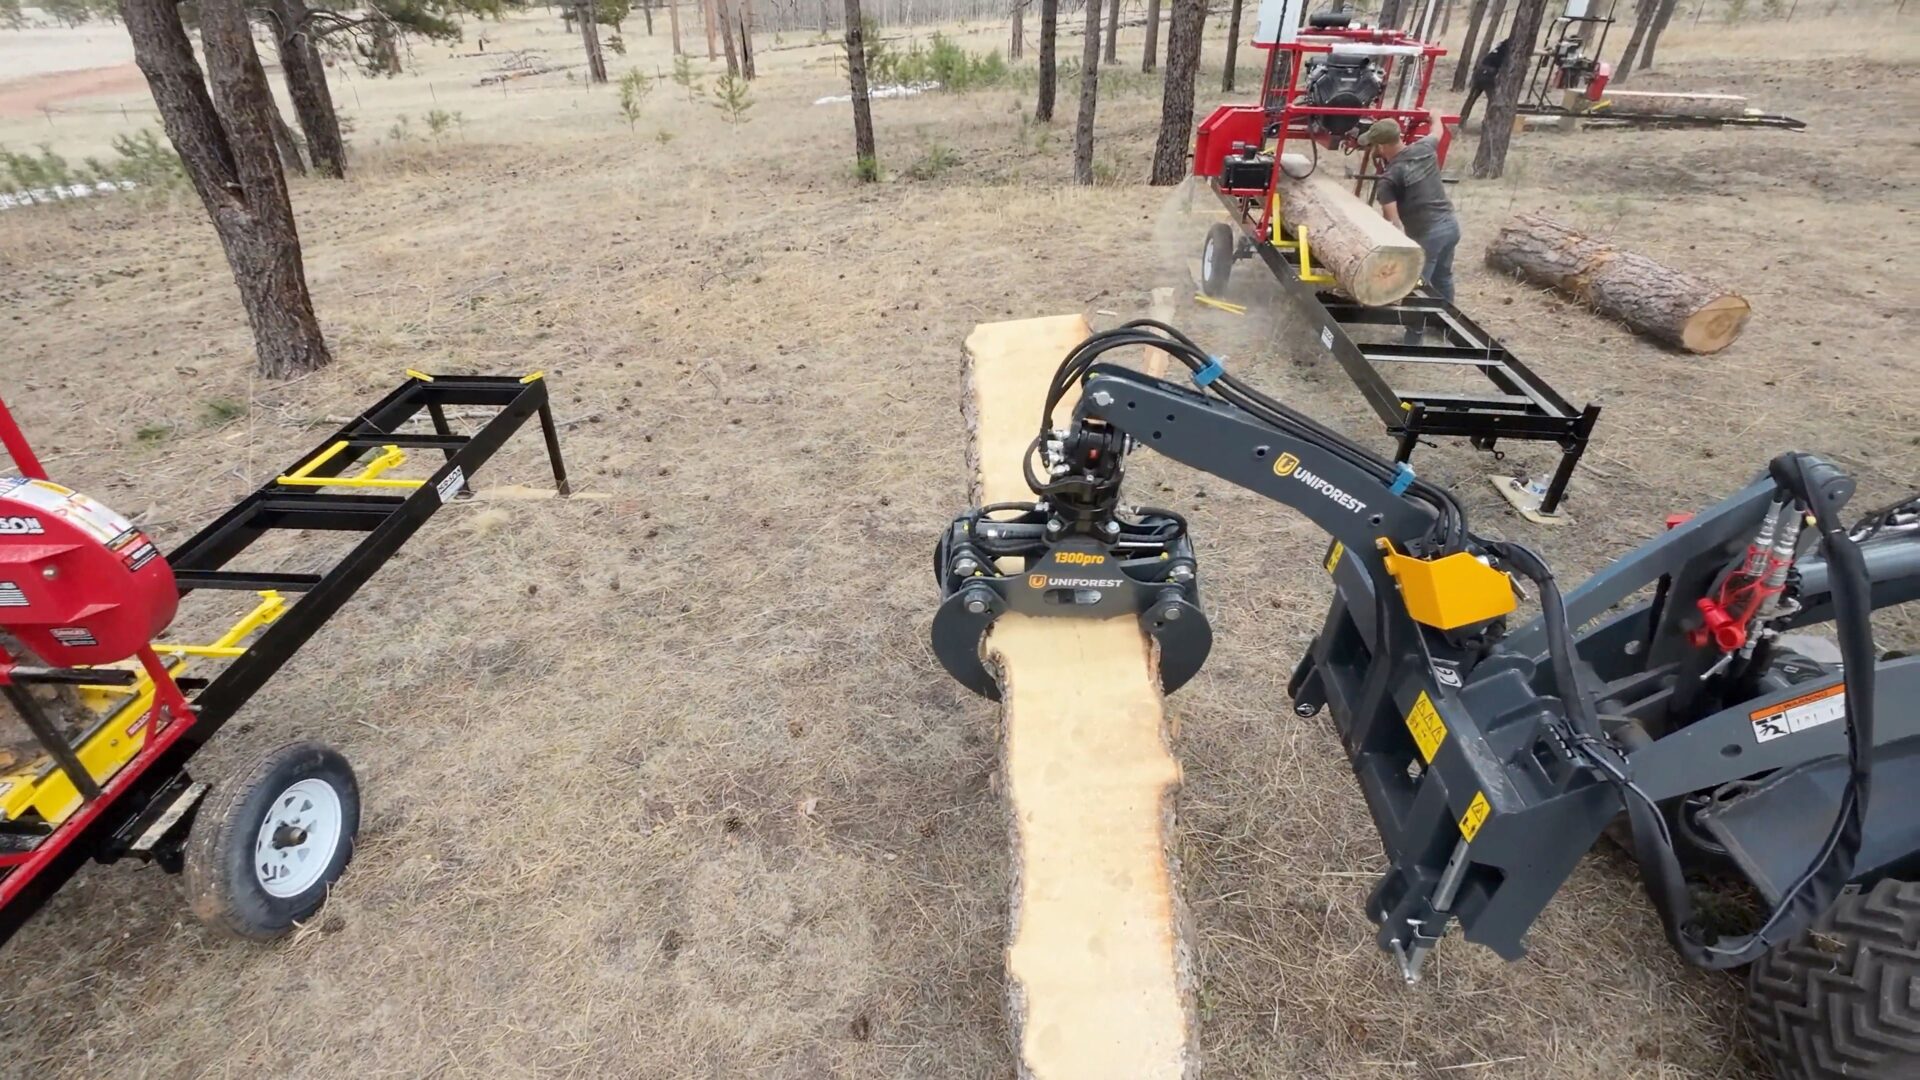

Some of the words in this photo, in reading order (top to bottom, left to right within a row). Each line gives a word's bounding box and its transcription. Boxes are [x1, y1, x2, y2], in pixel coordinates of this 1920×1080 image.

[1293, 467, 1367, 513] UNIFOREST
[1055, 551, 1105, 566] 1300pro
[1048, 578, 1124, 588] UNIFOREST
